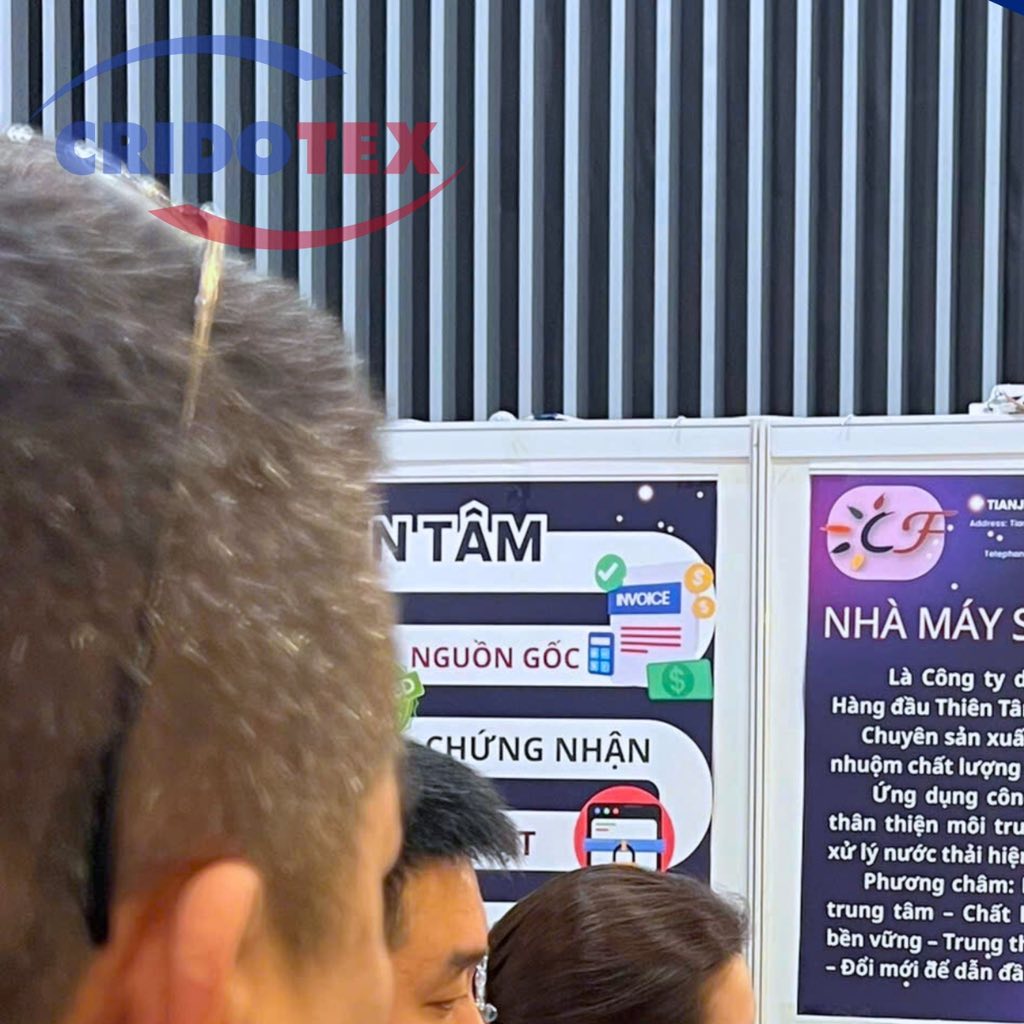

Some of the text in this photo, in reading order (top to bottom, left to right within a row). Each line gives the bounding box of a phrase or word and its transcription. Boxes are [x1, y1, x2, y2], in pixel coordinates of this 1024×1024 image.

[423, 507, 541, 562] TÂM
[615, 591, 670, 606] INVOICE
[824, 599, 907, 640] NHÀ
[919, 600, 1003, 640] MÁY
[411, 640, 579, 669] NGUỒN GỐC
[889, 666, 913, 686] Là
[921, 667, 975, 692] Công
[983, 670, 1006, 693] ty
[832, 695, 885, 720] Hàng
[890, 695, 930, 716] đầu
[934, 697, 993, 717] Thiên
[556, 731, 650, 770] NHẬN
[861, 725, 939, 750] Chuyên
[944, 725, 981, 747] sản
[830, 754, 903, 778] nhuộm
[907, 755, 954, 776] chất
[959, 756, 1021, 782] lượng
[872, 780, 917, 809] Ứng
[925, 785, 978, 810] dụng
[828, 812, 876, 832] thân
[884, 814, 939, 838] thiện
[947, 815, 986, 835] môi
[827, 840, 857, 860] xử
[860, 842, 879, 866] lý
[884, 843, 937, 863] nước
[941, 843, 983, 864] thải
[864, 872, 945, 897] Phương
[951, 874, 1015, 894] châm:
[826, 901, 884, 924] trung
[893, 901, 934, 921] tâm
[962, 903, 1011, 923] Chất
[826, 927, 864, 948] bền
[869, 930, 922, 954] vững
[942, 932, 1004, 958] Trung
[840, 955, 874, 977] Đổi
[879, 959, 919, 983] mới
[924, 958, 951, 979] để
[954, 959, 993, 981] dẫn
